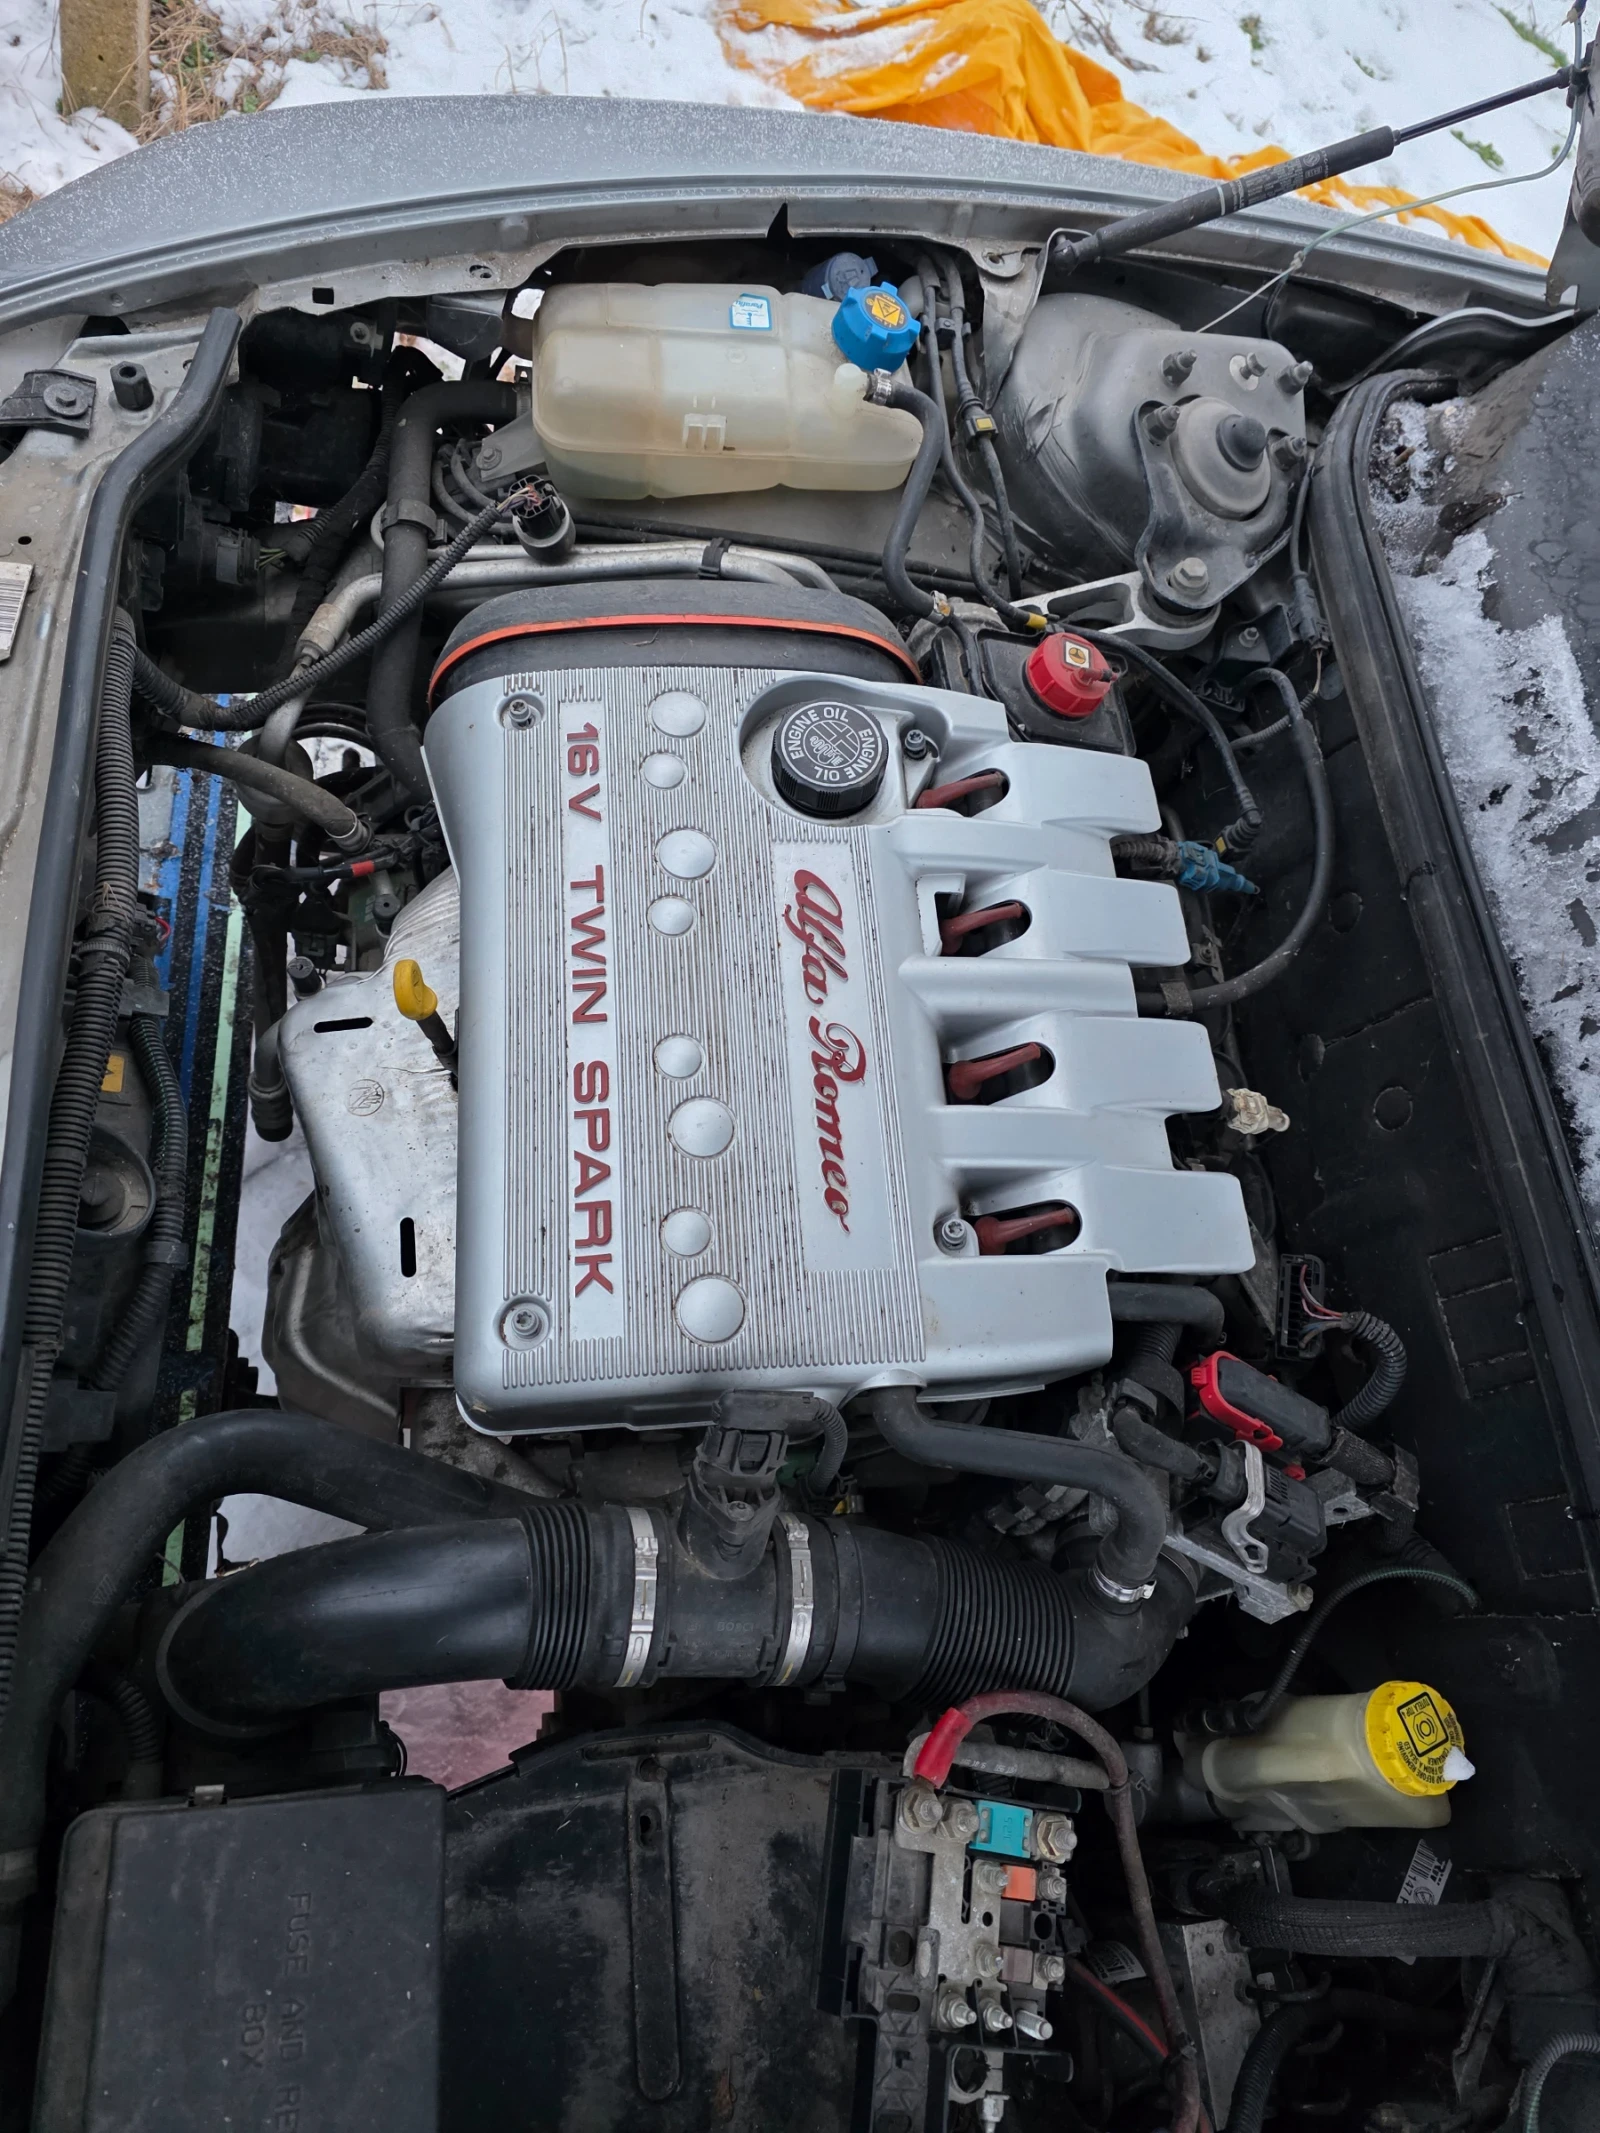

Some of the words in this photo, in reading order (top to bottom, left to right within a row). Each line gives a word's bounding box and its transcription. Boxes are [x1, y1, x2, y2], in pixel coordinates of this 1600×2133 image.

[787, 709, 820, 759] ENGINE
[823, 706, 849, 723] OIL
[843, 728, 876, 779] ENGINE
[566, 721, 602, 822] 16V
[814, 765, 840, 781] OIL
[570, 864, 607, 1023] TWIN
[781, 869, 848, 1005] Alfa
[808, 1015, 867, 1234] Romeo
[573, 1060, 613, 1298] SPARK
[1406, 1706, 1415, 1717] TOP
[1414, 1697, 1431, 1713] TUTELA
[1396, 1741, 1417, 1773] REMOVING
[1404, 1741, 1420, 1765] SEALED
[1416, 1769, 1435, 1784] BEFORE
[1424, 1765, 1438, 1777] FROM
[1403, 1874, 1417, 1896] 147
[286, 1893, 311, 1976] FUSE
[241, 2003, 267, 2068] BOX
[280, 2000, 305, 2061] AND
[272, 2083, 302, 2133] RE
